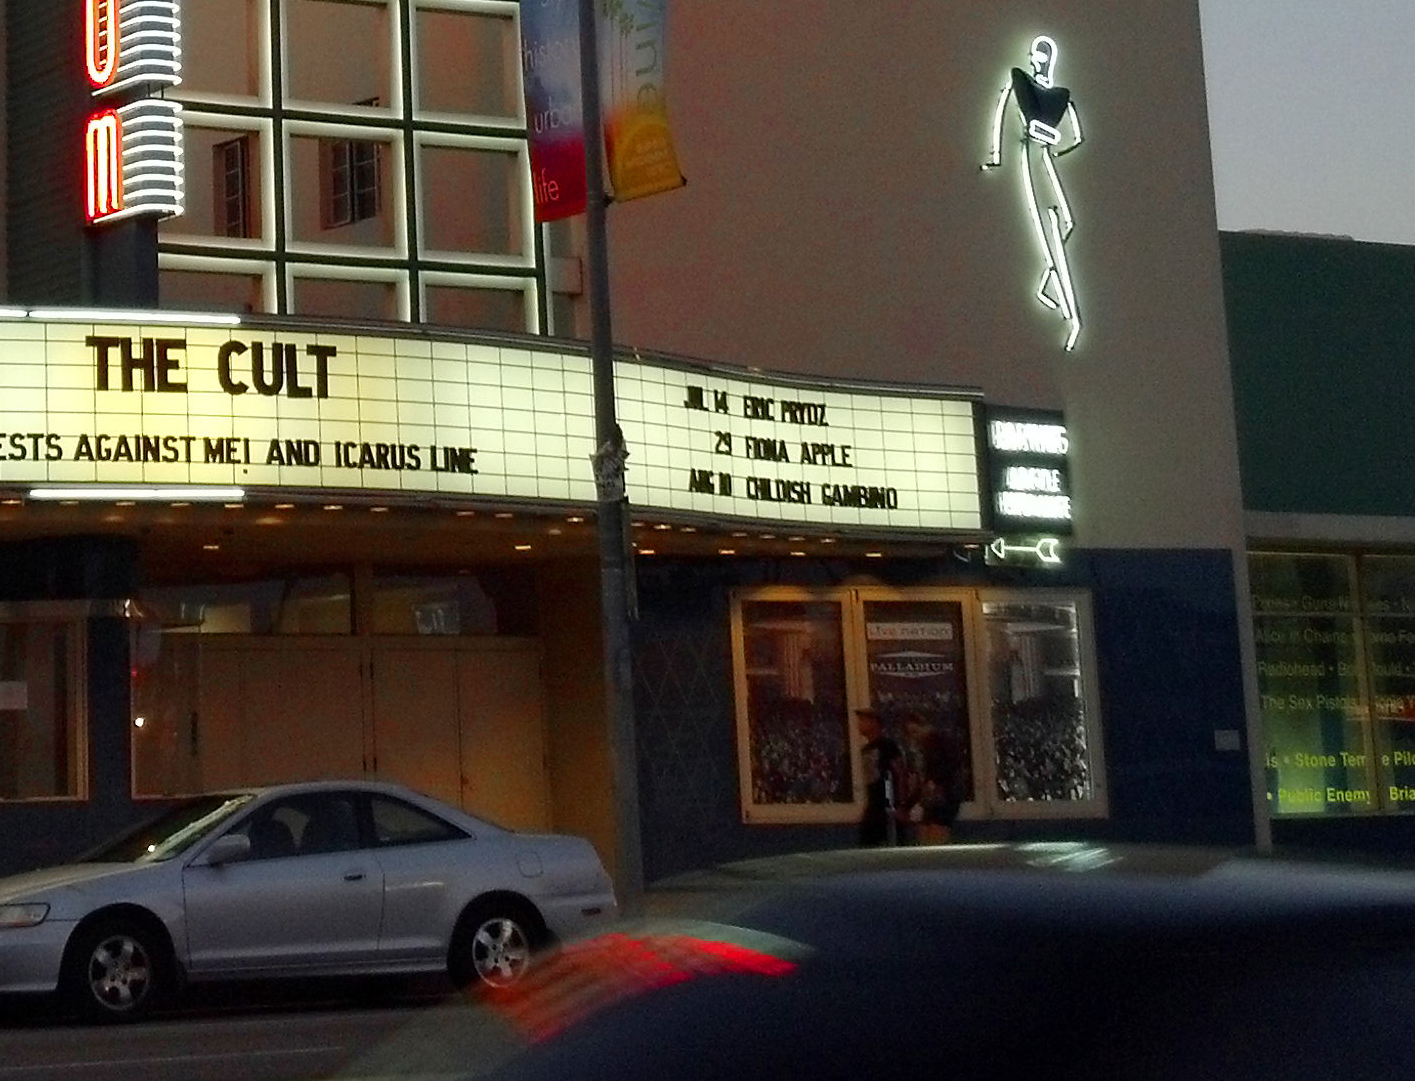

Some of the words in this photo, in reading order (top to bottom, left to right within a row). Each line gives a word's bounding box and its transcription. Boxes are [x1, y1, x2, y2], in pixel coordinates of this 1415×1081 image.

[86, 335, 188, 394] THE
[218, 340, 337, 399] CULT
[74, 434, 196, 464] AGAINST
[203, 436, 251, 475] ME!
[266, 439, 320, 468] AND
[335, 441, 421, 472] ICARUS
[430, 446, 479, 476] LINE
[715, 430, 732, 456] 29
[745, 435, 790, 463] FIONA
[800, 441, 853, 468] APPLE
[746, 476, 811, 504] CHILDISH
[821, 482, 898, 509] GAMBINO
[869, 662, 954, 671] PALLADIUM
[1295, 752, 1336, 768] Stone
[1278, 787, 1323, 802] Public
[1327, 787, 1371, 806] Enemy
